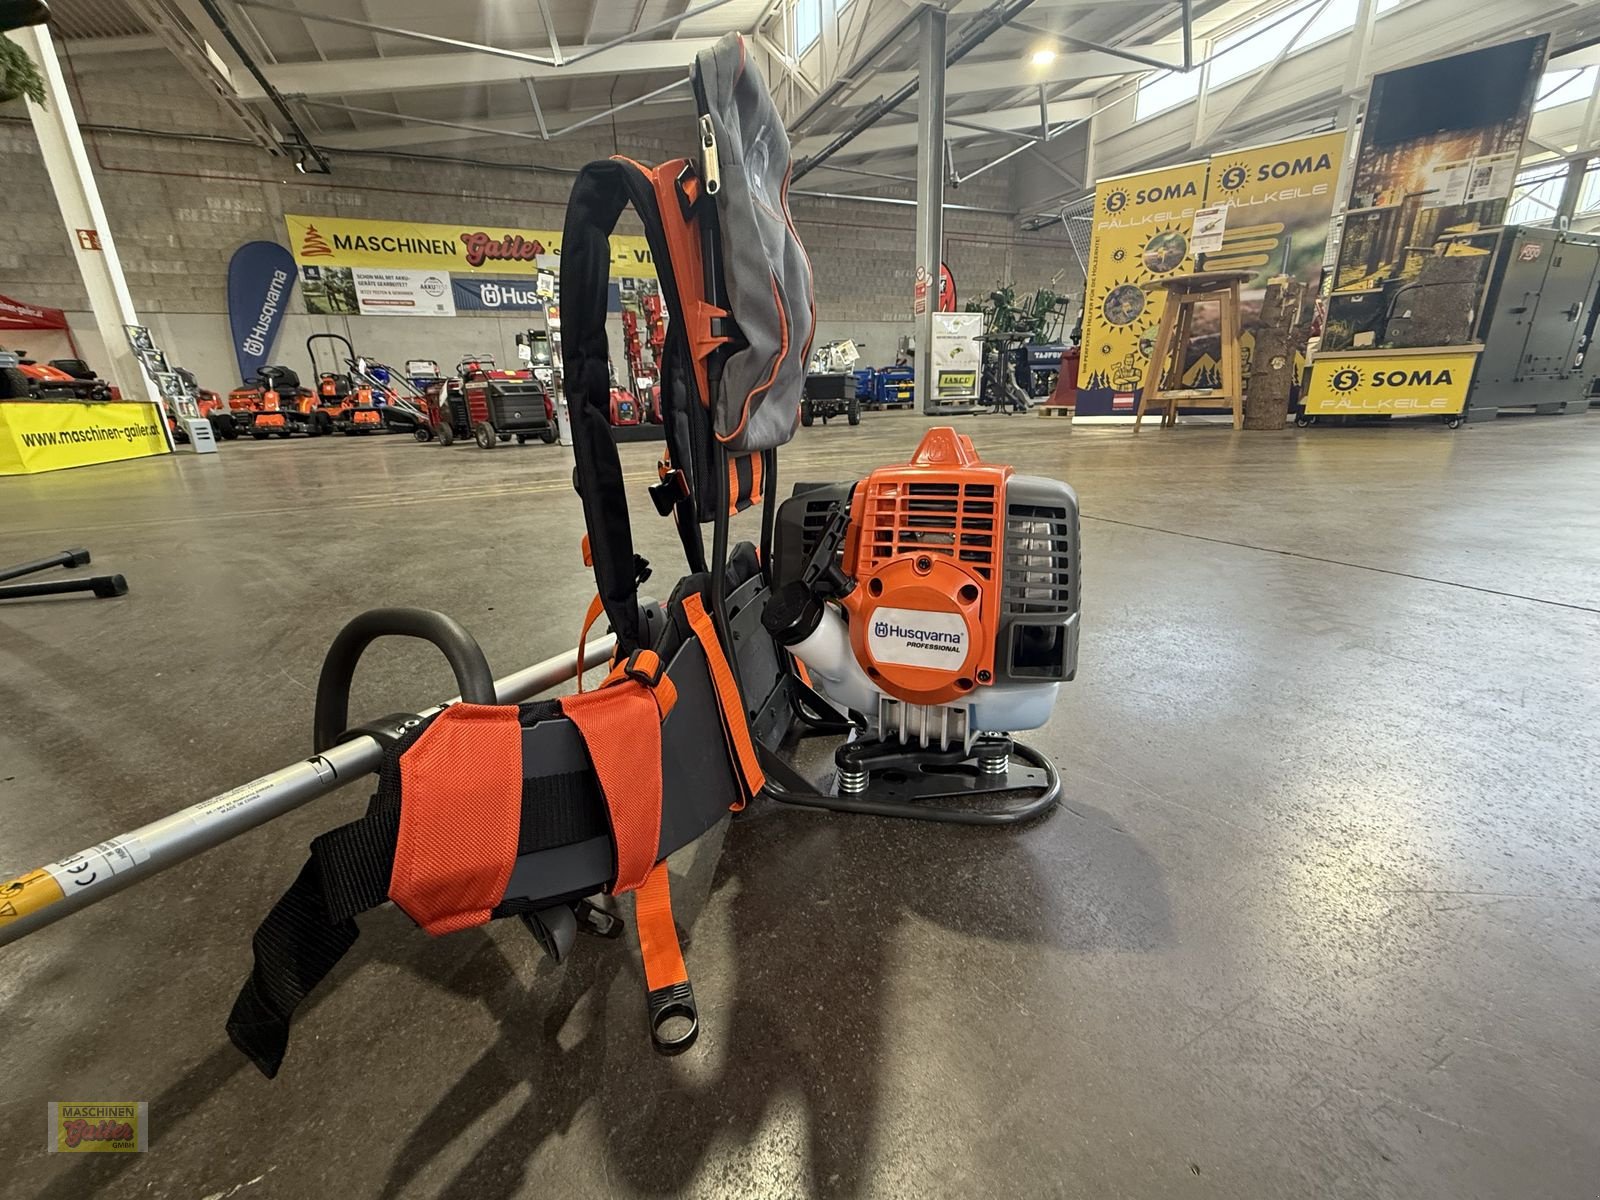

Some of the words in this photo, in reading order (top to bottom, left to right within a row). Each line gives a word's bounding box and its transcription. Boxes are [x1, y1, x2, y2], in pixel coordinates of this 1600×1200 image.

[1256, 153, 1331, 182] SOMA
[1135, 181, 1197, 205] SOMA
[1097, 207, 1195, 231] FÄLLKEILE
[332, 233, 456, 256] MASCHINEN
[460, 232, 545, 267] Gailer
[633, 249, 652, 263] VI
[250, 269, 287, 342] Husqvarna
[1371, 369, 1453, 388] SOMA
[1319, 397, 1449, 410] FÄLLKEILE
[21, 423, 160, 447] www.maschinen-gailer.at
[889, 625, 961, 644] Husqvarna
[906, 641, 961, 653] PROFESSIONAL
